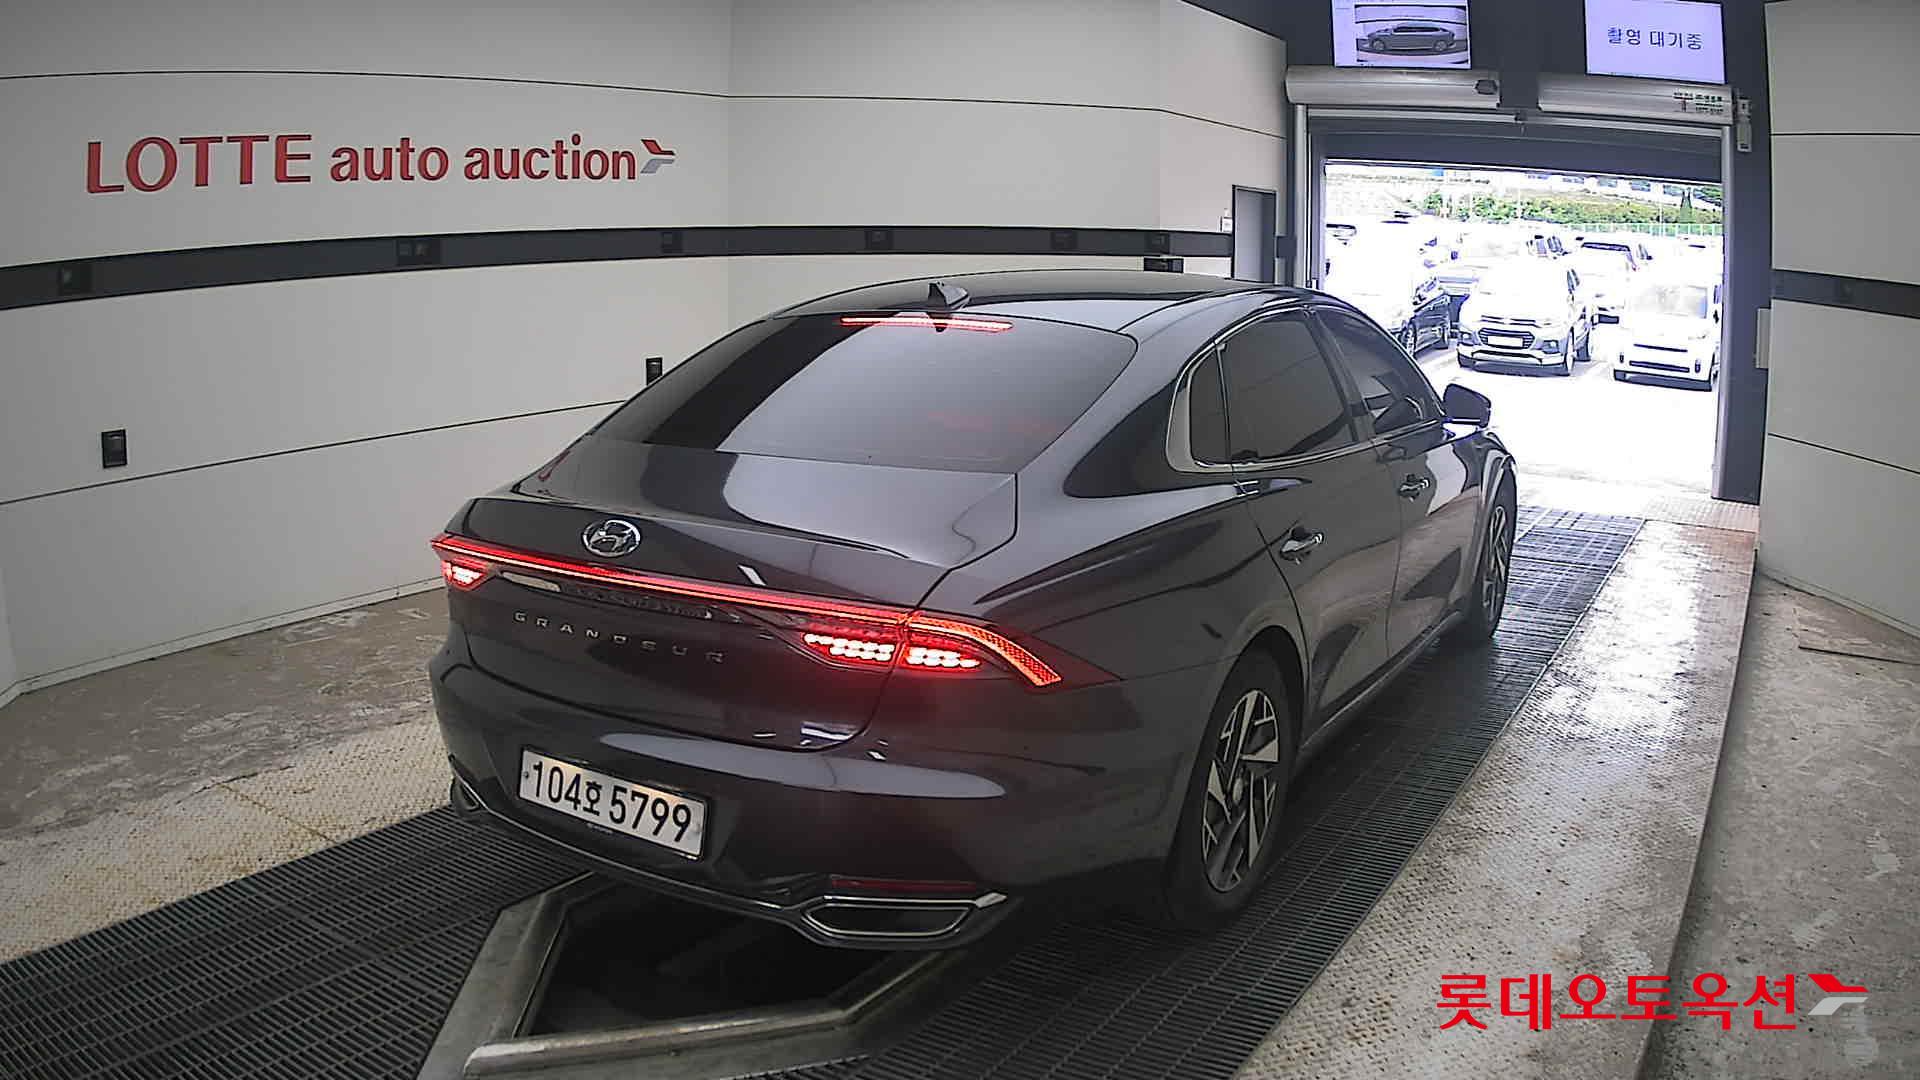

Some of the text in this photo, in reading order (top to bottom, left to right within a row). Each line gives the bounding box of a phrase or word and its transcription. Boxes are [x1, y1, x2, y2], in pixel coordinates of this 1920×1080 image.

[1649, 30, 1702, 51] 대기중
[86, 133, 636, 194] LOTTE auto auction
[514, 611, 725, 664] GRANDEUR
[533, 760, 692, 842] 104호 5799
